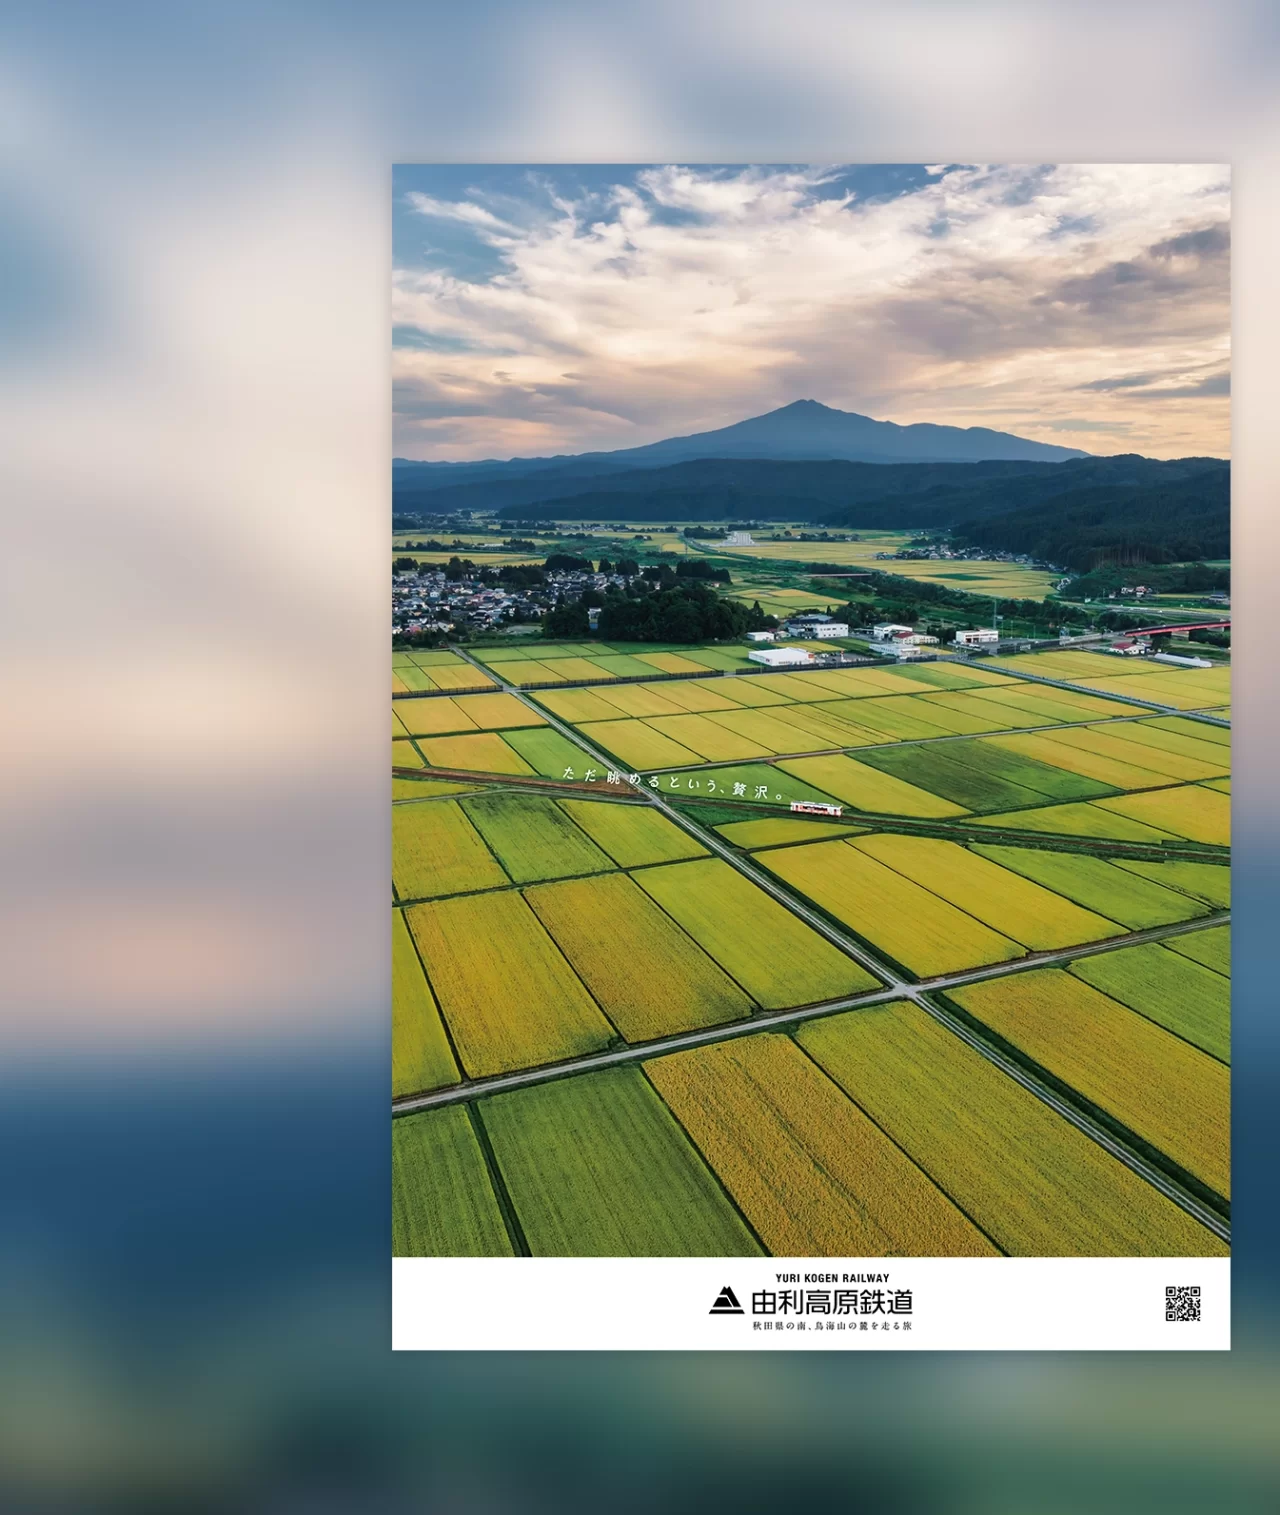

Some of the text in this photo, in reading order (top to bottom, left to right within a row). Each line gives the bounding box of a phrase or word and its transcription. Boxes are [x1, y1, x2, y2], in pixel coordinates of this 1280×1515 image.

[562, 766, 783, 801] ただ眺めるという、贅沢。
[775, 1273, 890, 1283] YURI KOGEN RAILWAY
[752, 1289, 913, 1315] 由利高原鉄道
[752, 1321, 912, 1331] 秋田県の南、鳥海山の麓を走る旅
